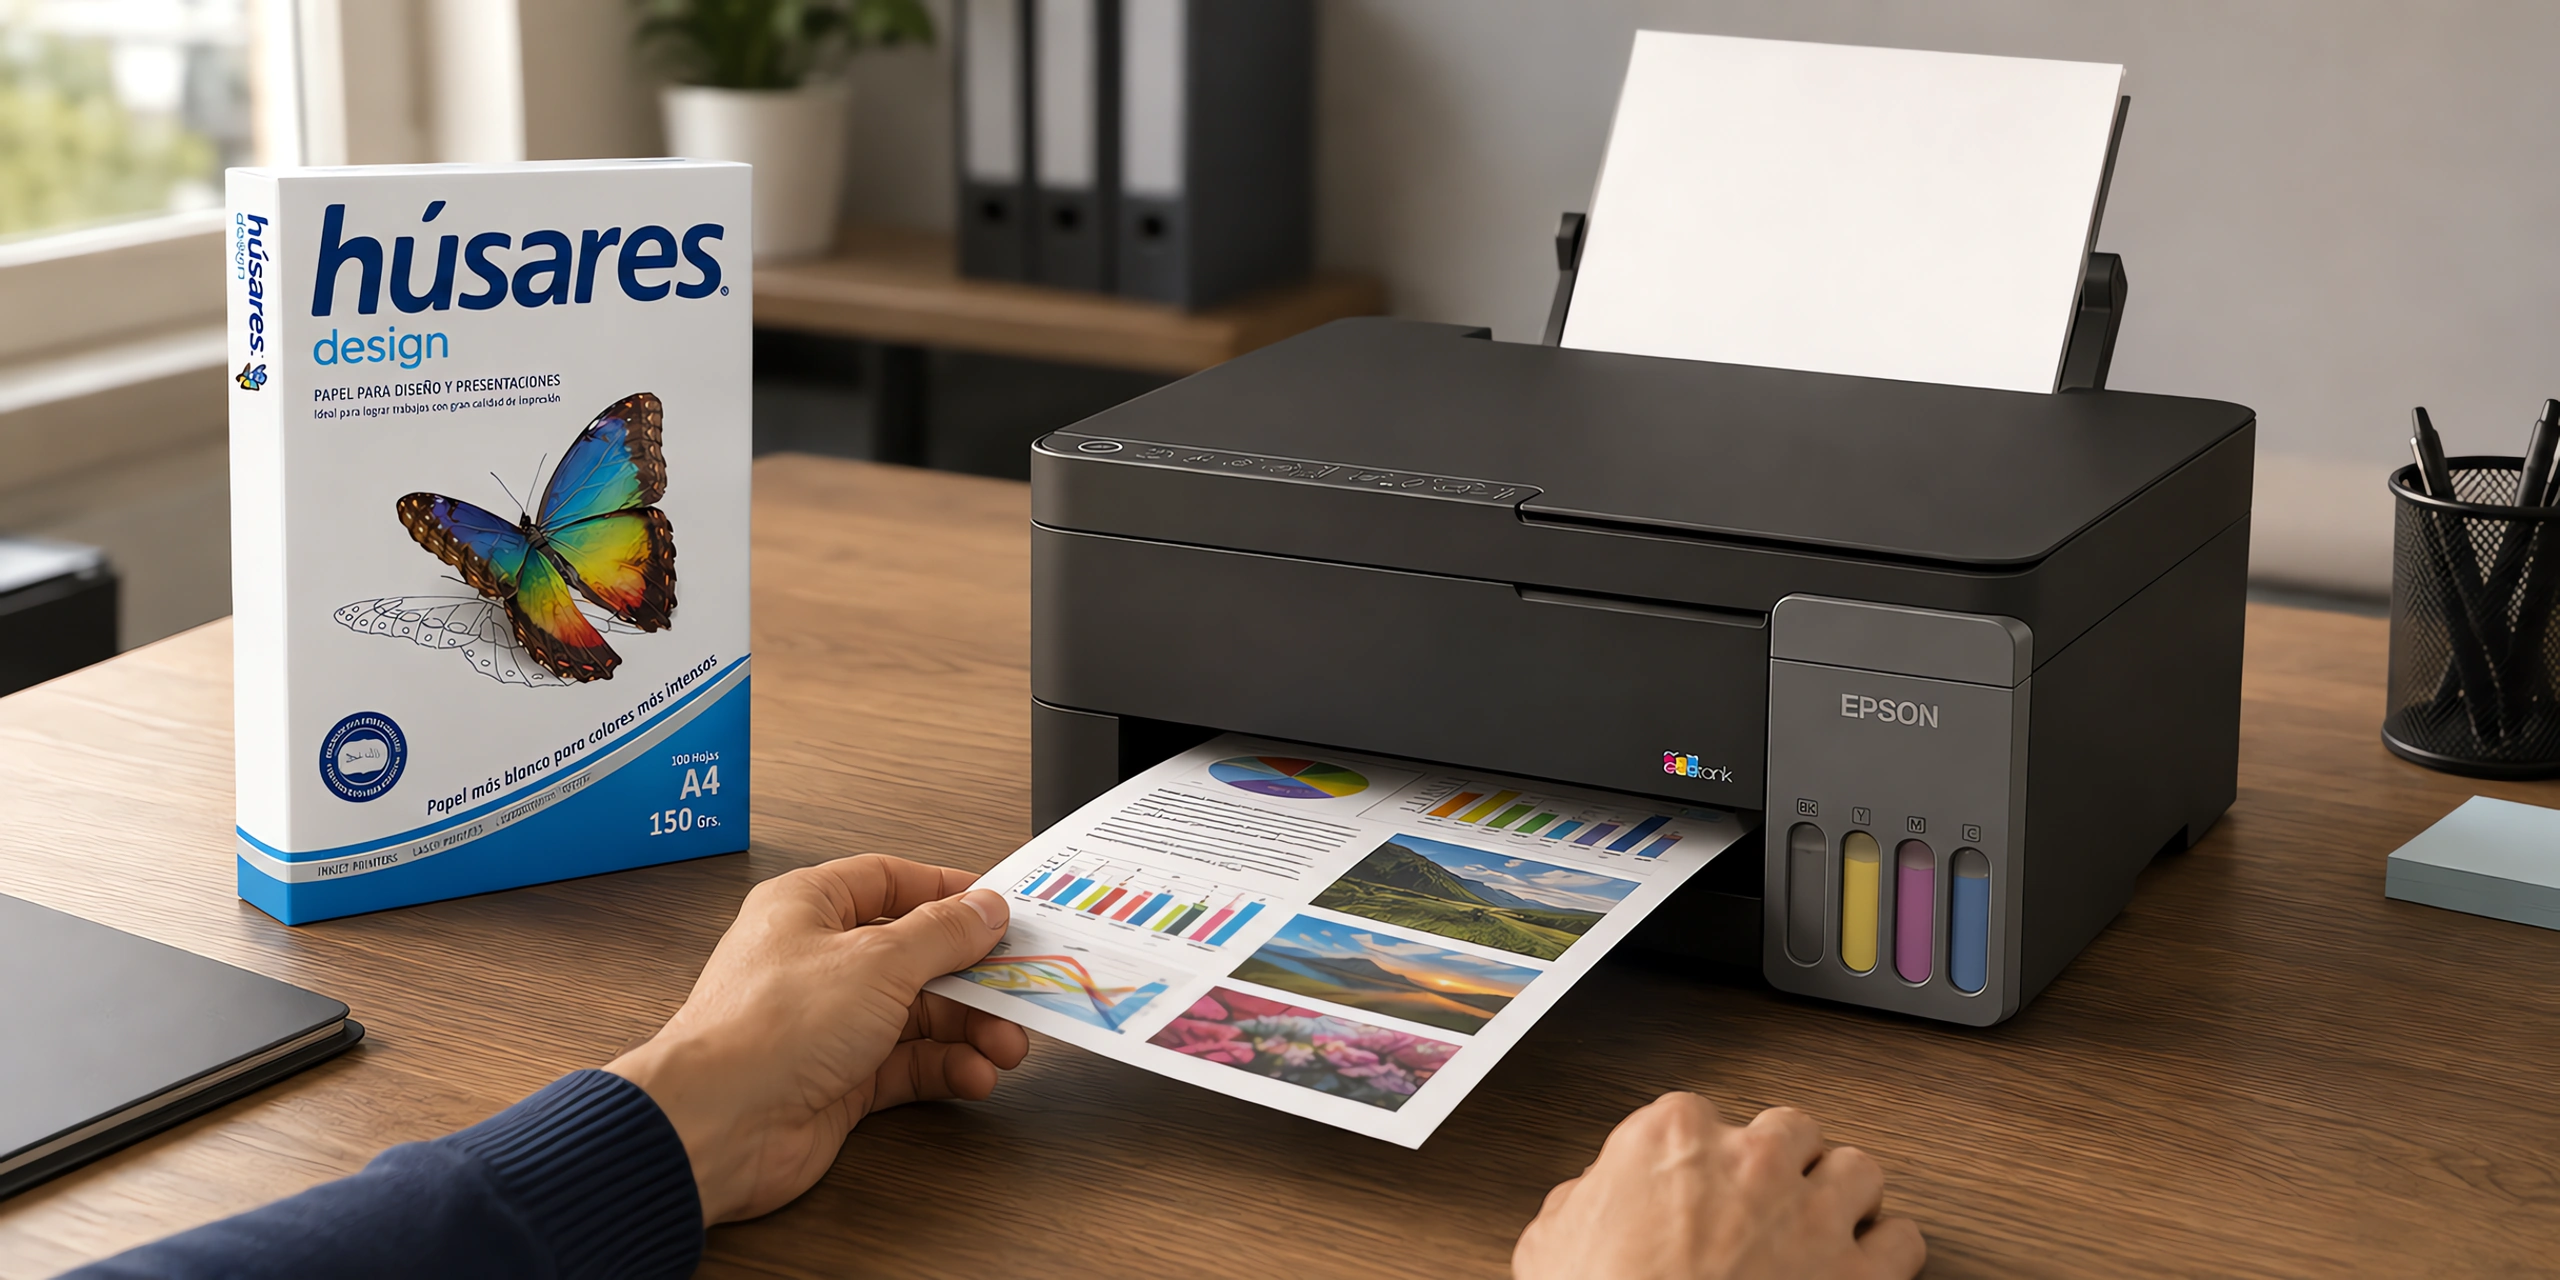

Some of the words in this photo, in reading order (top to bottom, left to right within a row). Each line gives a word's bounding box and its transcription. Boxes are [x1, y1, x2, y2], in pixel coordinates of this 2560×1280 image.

[310, 199, 726, 318] húsares
[247, 213, 270, 354] húsares
[312, 325, 449, 370] design
[314, 387, 354, 402] PAPEL
[357, 385, 391, 399] PARA
[395, 379, 441, 397] DISEÑO
[445, 380, 453, 394] Y
[456, 374, 561, 393] PRESENTACIONES
[340, 408, 360, 420] para
[363, 406, 389, 418] lograr
[432, 403, 449, 412] con
[450, 401, 471, 412] gran
[1840, 692, 1940, 730] EPSON
[427, 787, 467, 816] Papel
[504, 756, 550, 786] blanco
[554, 737, 586, 768] para
[588, 708, 635, 744] colores
[666, 653, 719, 698] intensos
[671, 754, 691, 767] 100
[692, 750, 720, 765] Hojas
[680, 765, 721, 801] A4
[649, 807, 693, 836] 150
[697, 814, 722, 829] Grs.
[1798, 800, 1817, 815] BK
[1855, 809, 1866, 823] Y
[1909, 818, 1923, 832] M
